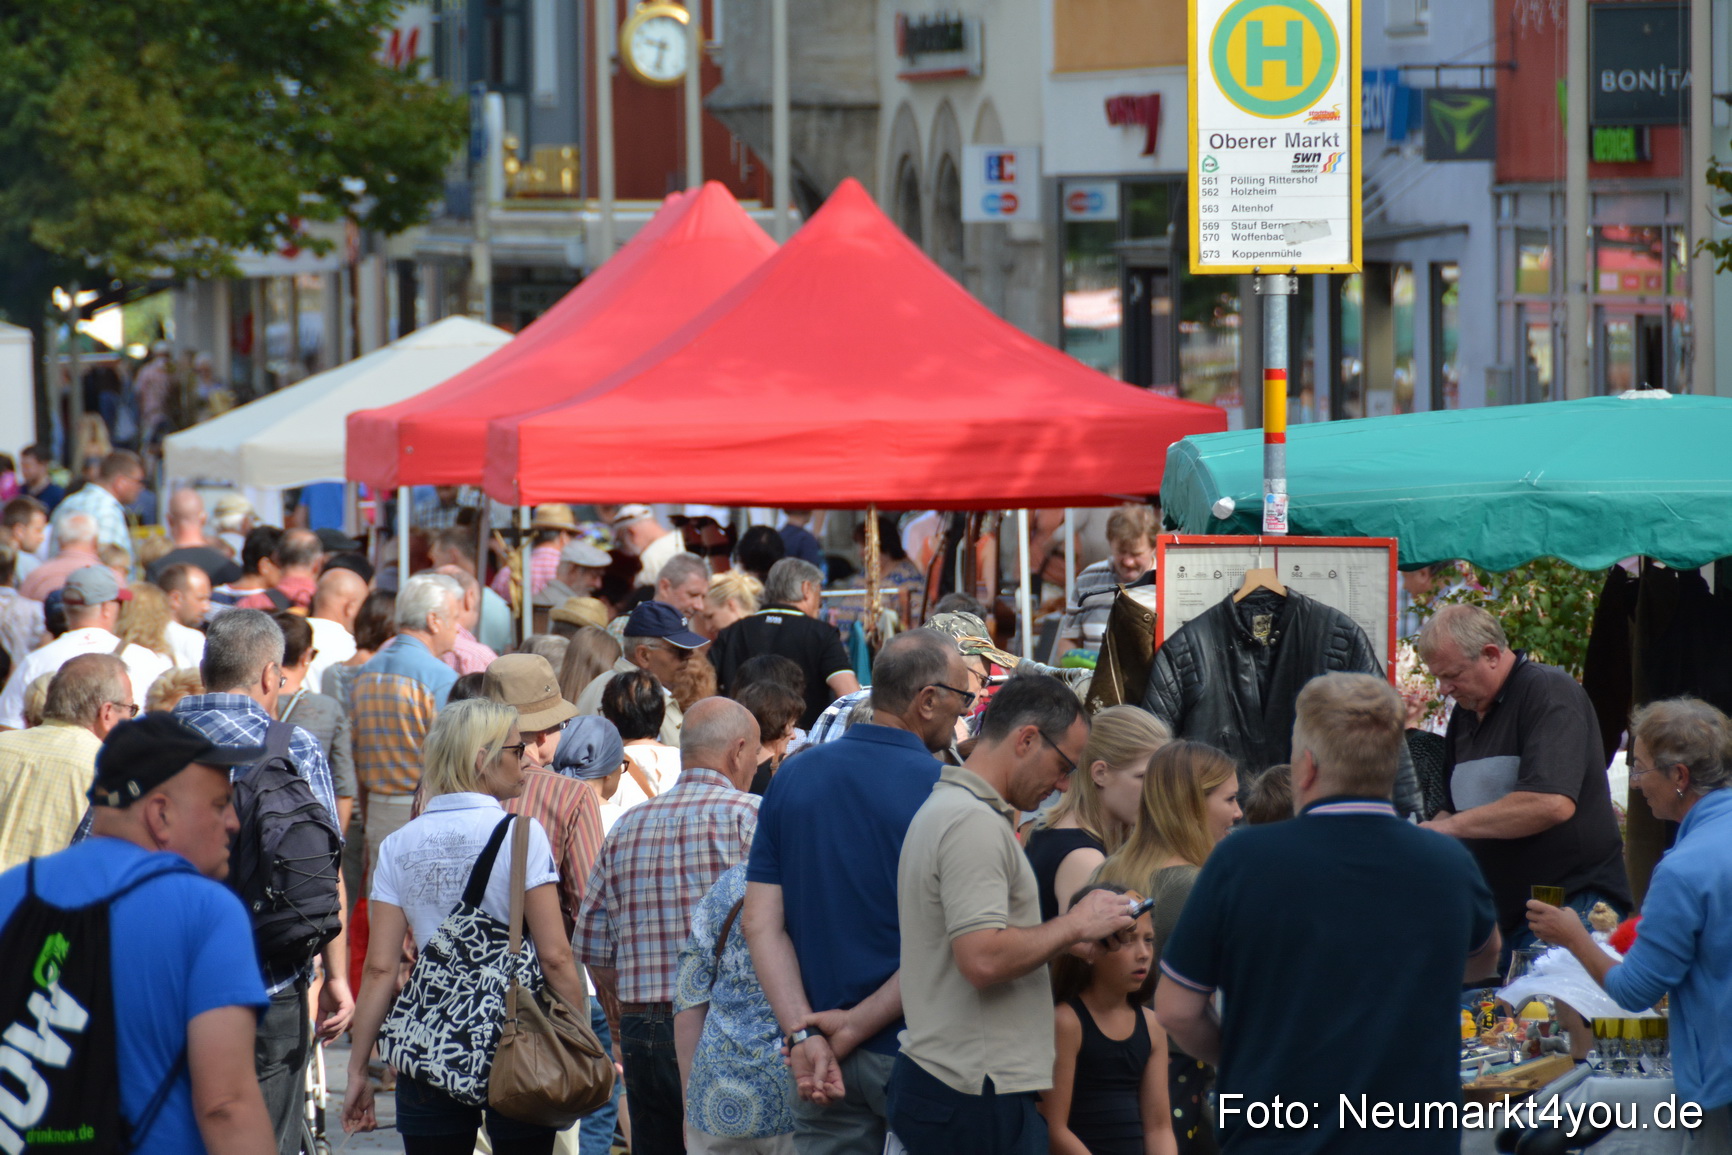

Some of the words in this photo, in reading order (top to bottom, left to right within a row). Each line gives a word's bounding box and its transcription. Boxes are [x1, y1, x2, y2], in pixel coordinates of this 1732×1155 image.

[1246, 20, 1303, 87] H
[1601, 63, 1692, 97] BONITA
[1209, 133, 1277, 149] Oberer
[1285, 132, 1339, 148] Markt
[1292, 152, 1322, 163] swn
[1202, 177, 1218, 185] 561
[1230, 176, 1265, 186] Pölling
[1269, 176, 1318, 184] Rittershof
[1202, 188, 1219, 196] 562
[1230, 187, 1277, 196] Holzheim
[1202, 205, 1219, 213] 563
[1231, 204, 1274, 212] Altenhof
[1202, 222, 1219, 230] 569
[1231, 221, 1257, 230] Stauf
[1202, 233, 1220, 241] 570
[1231, 232, 1285, 241] Woffenbac
[1202, 250, 1220, 258] 573
[1232, 249, 1302, 259] Koppenmühle
[26, 1123, 95, 1146] drinknow.de
